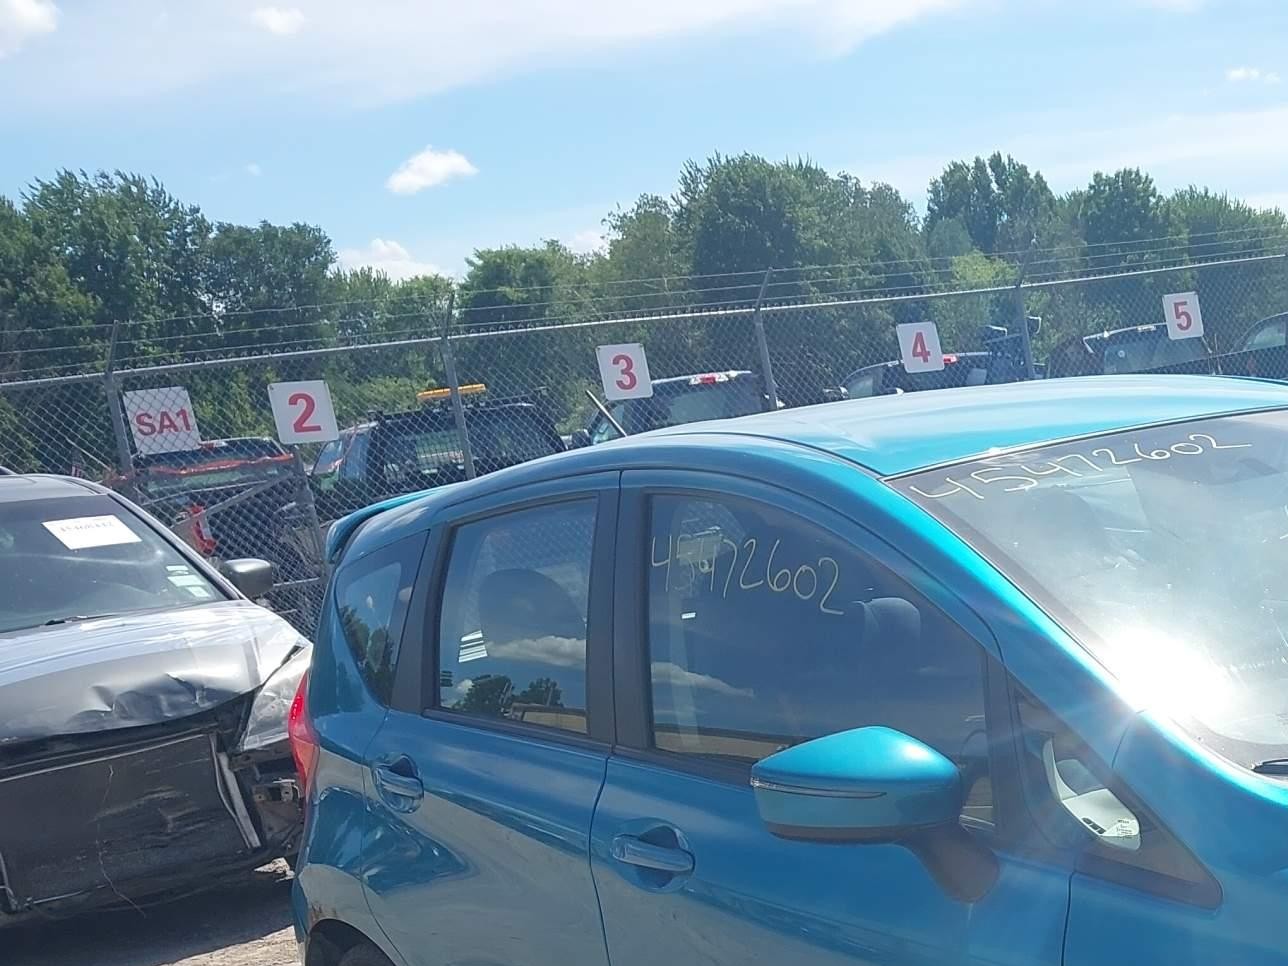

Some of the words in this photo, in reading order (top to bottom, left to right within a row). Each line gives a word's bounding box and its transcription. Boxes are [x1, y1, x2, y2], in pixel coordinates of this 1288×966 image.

[1173, 301, 1192, 331] 5
[912, 331, 931, 363] 4
[612, 354, 637, 390] 3
[135, 408, 191, 437] SA1
[288, 393, 322, 433] 2
[909, 434, 1252, 500] 45472602
[651, 533, 845, 615] 45472602
